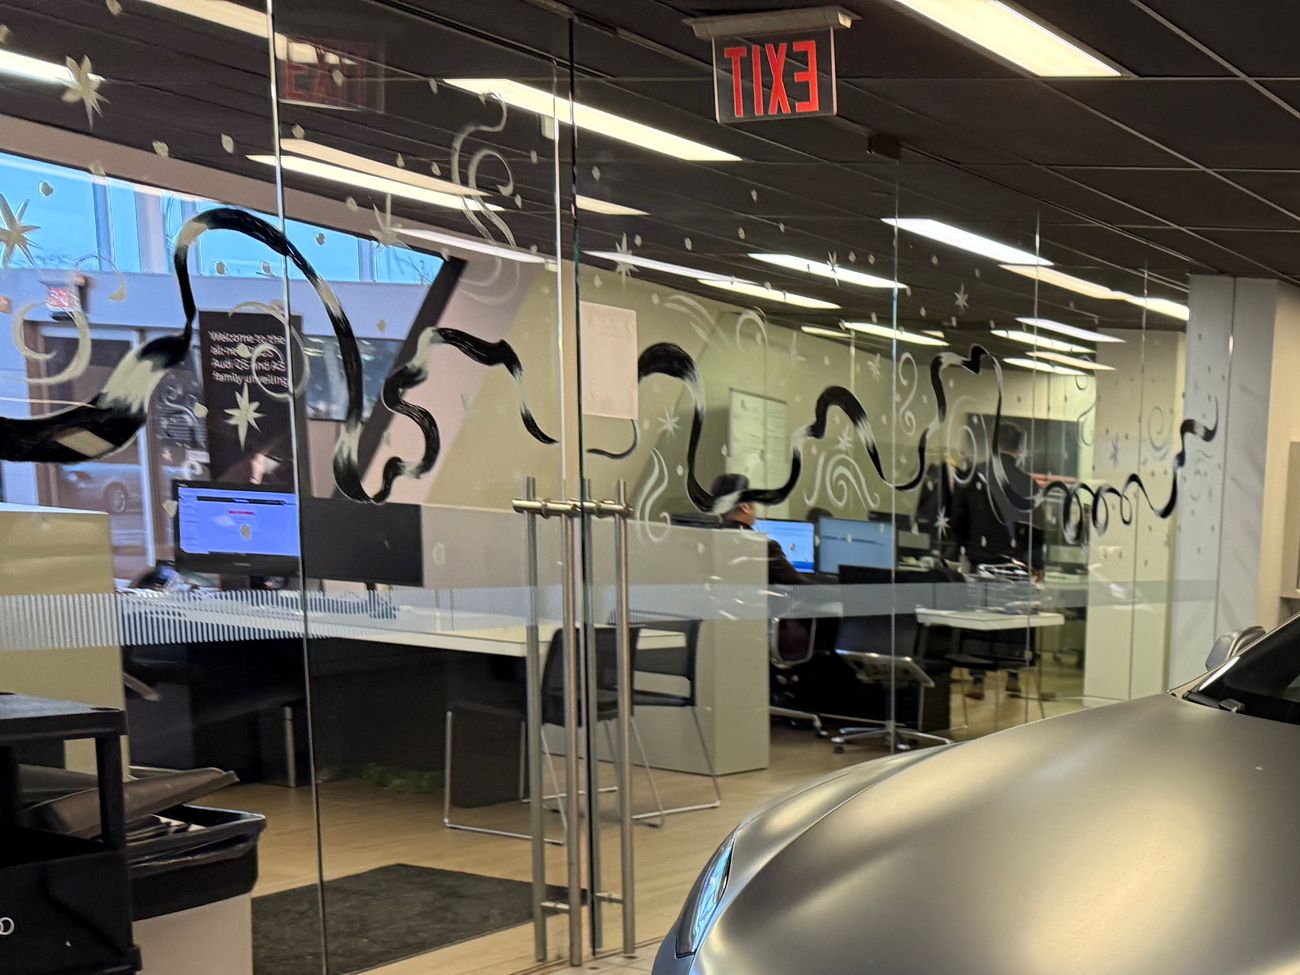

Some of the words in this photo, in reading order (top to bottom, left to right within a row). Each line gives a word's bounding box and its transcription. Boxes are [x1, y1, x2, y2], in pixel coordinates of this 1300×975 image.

[208, 331, 254, 344] Welcome
[255, 334, 266, 344] to
[266, 334, 286, 345] the
[211, 358, 234, 369] Audi
[212, 371, 242, 385] family
